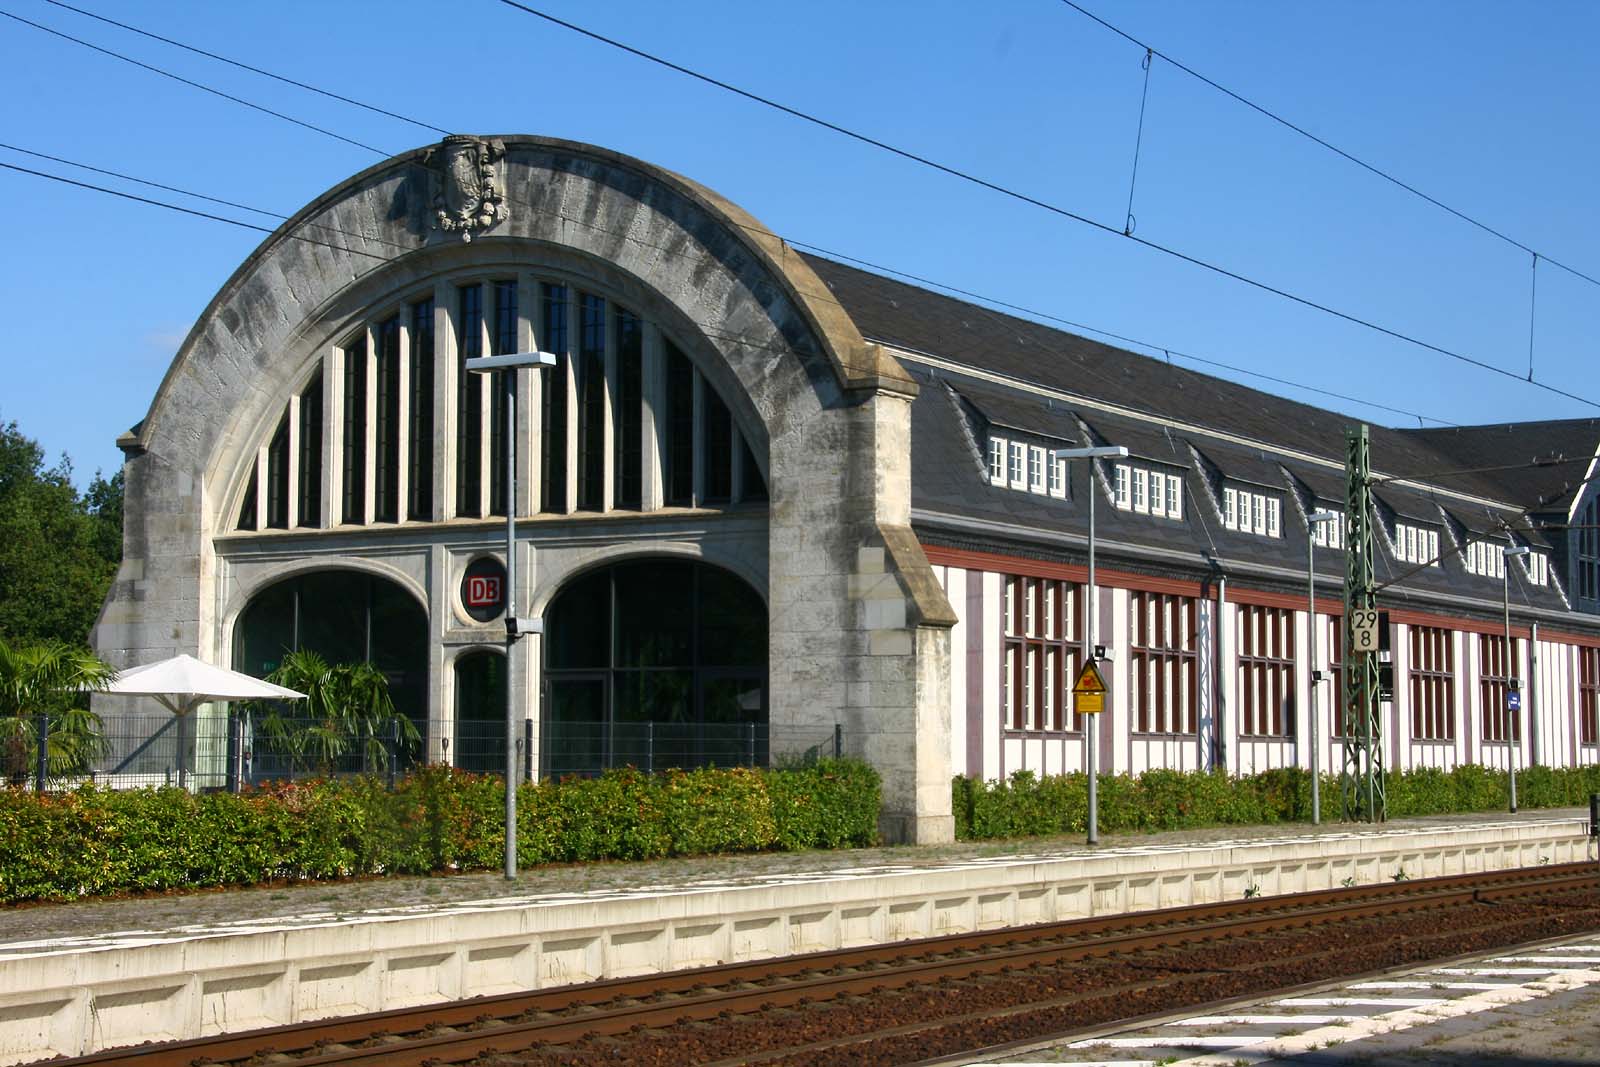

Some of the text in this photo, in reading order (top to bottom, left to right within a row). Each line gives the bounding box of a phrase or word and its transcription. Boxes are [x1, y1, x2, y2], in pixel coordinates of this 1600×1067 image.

[472, 579, 498, 602] DB
[1355, 612, 1377, 629] 29
[1360, 630, 1371, 647] 8
